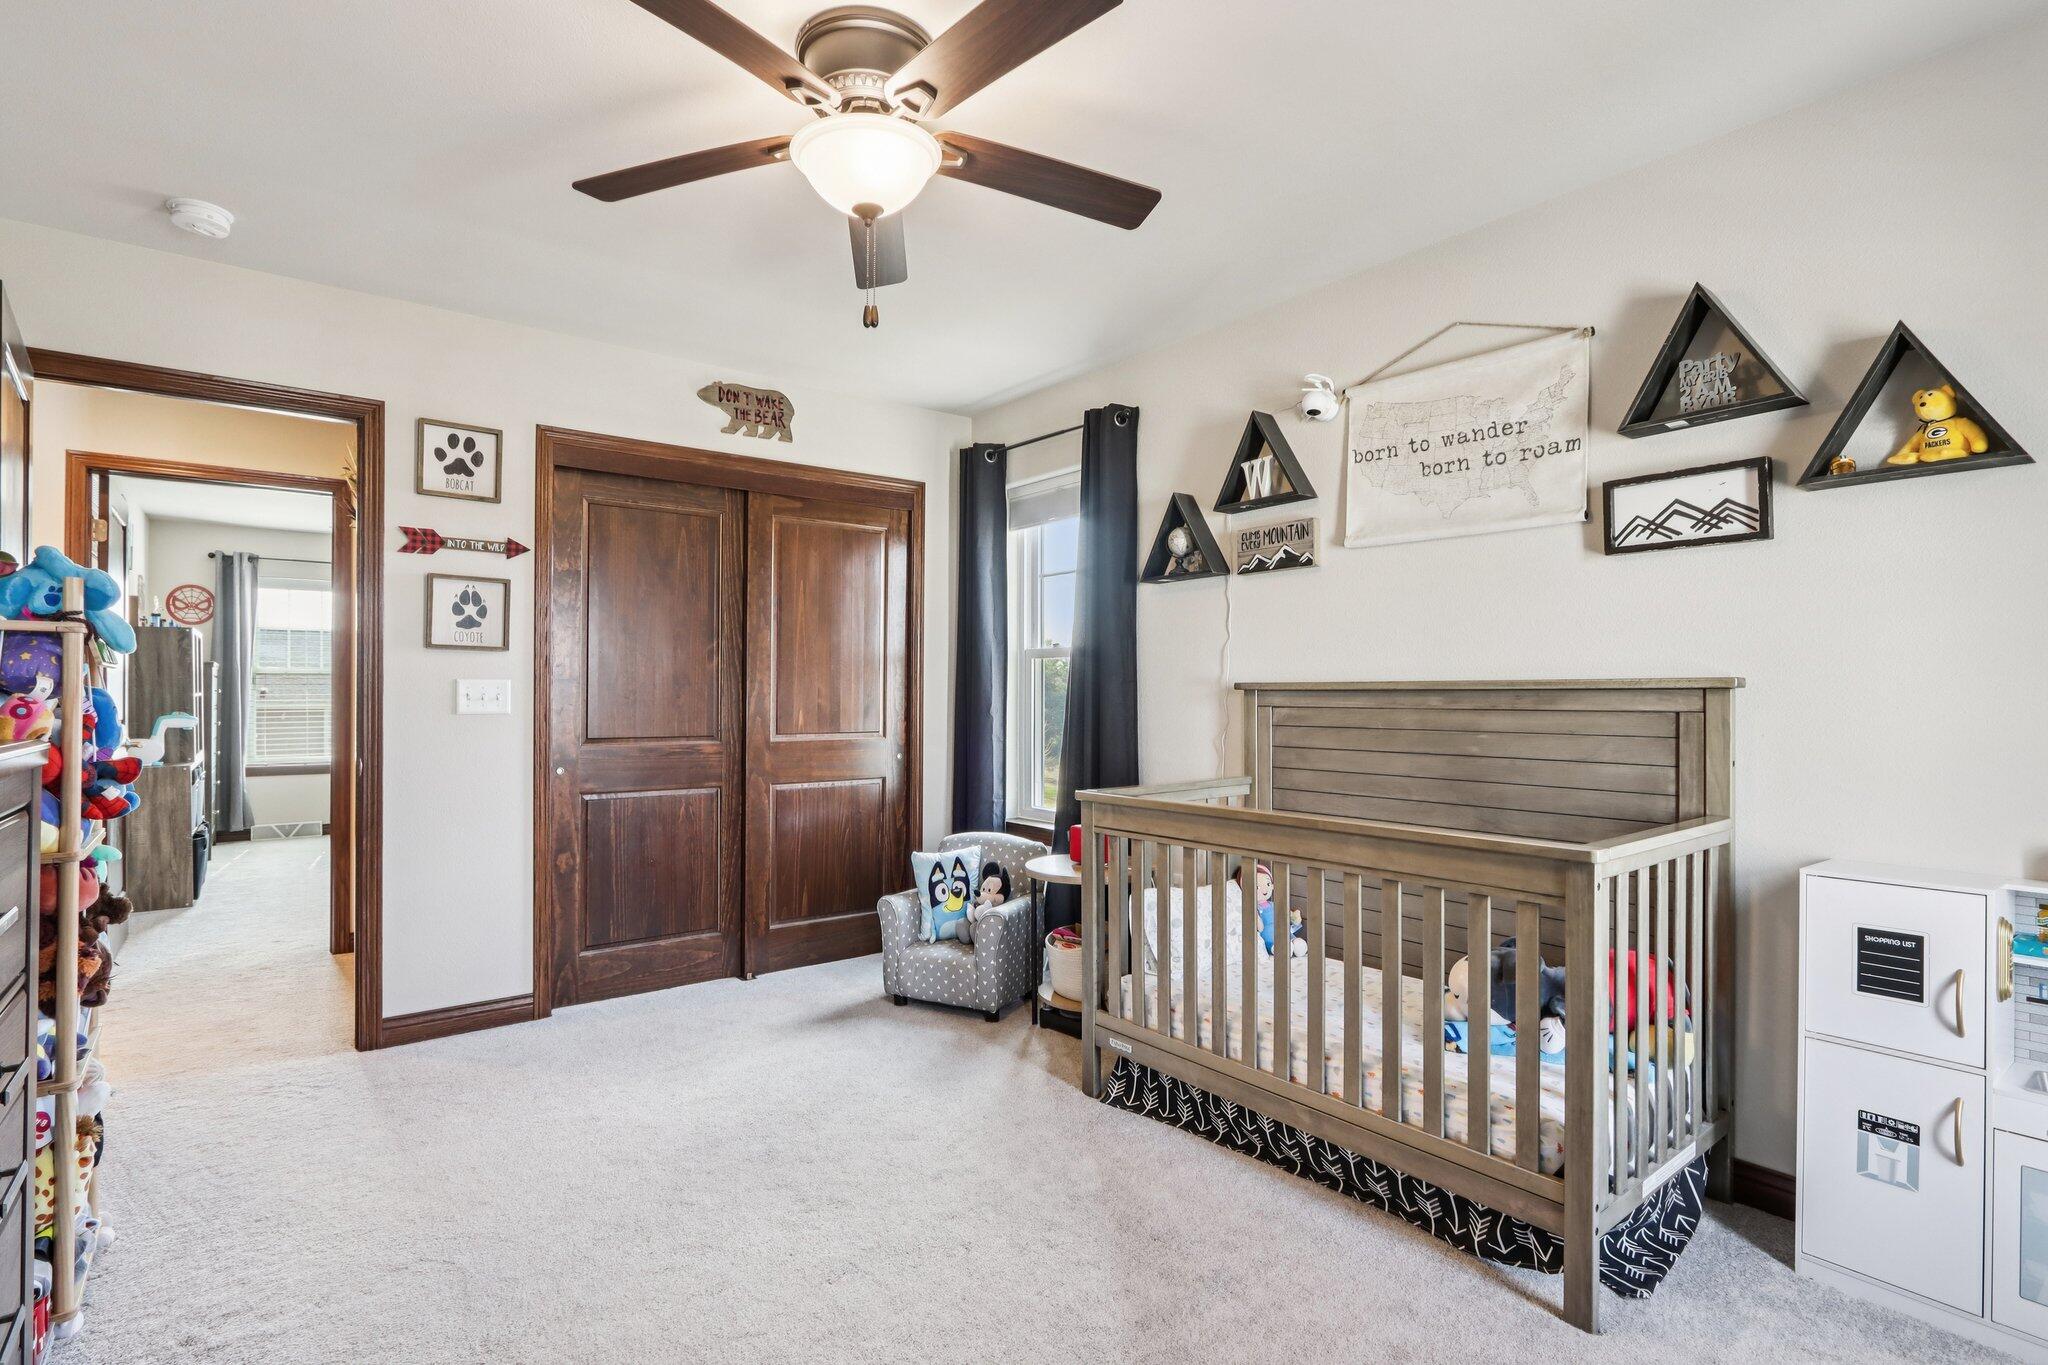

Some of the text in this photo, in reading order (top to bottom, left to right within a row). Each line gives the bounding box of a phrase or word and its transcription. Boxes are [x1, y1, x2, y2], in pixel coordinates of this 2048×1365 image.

[755, 395, 784, 411] WAKE
[734, 407, 786, 429] THE BEAR
[1353, 420, 1528, 464] born to wander
[1924, 438, 1951, 449] PACKERS
[1420, 437, 1582, 477] born to roam
[445, 477, 474, 491] BOBCAT
[1241, 521, 1309, 546] CLIMB MOUNTAIN
[447, 539, 505, 552] INTO THE WILD
[1241, 540, 1260, 551] EVERY
[454, 631, 483, 643] COYOTE
[1864, 935, 1916, 948] SHOPPING LIST
